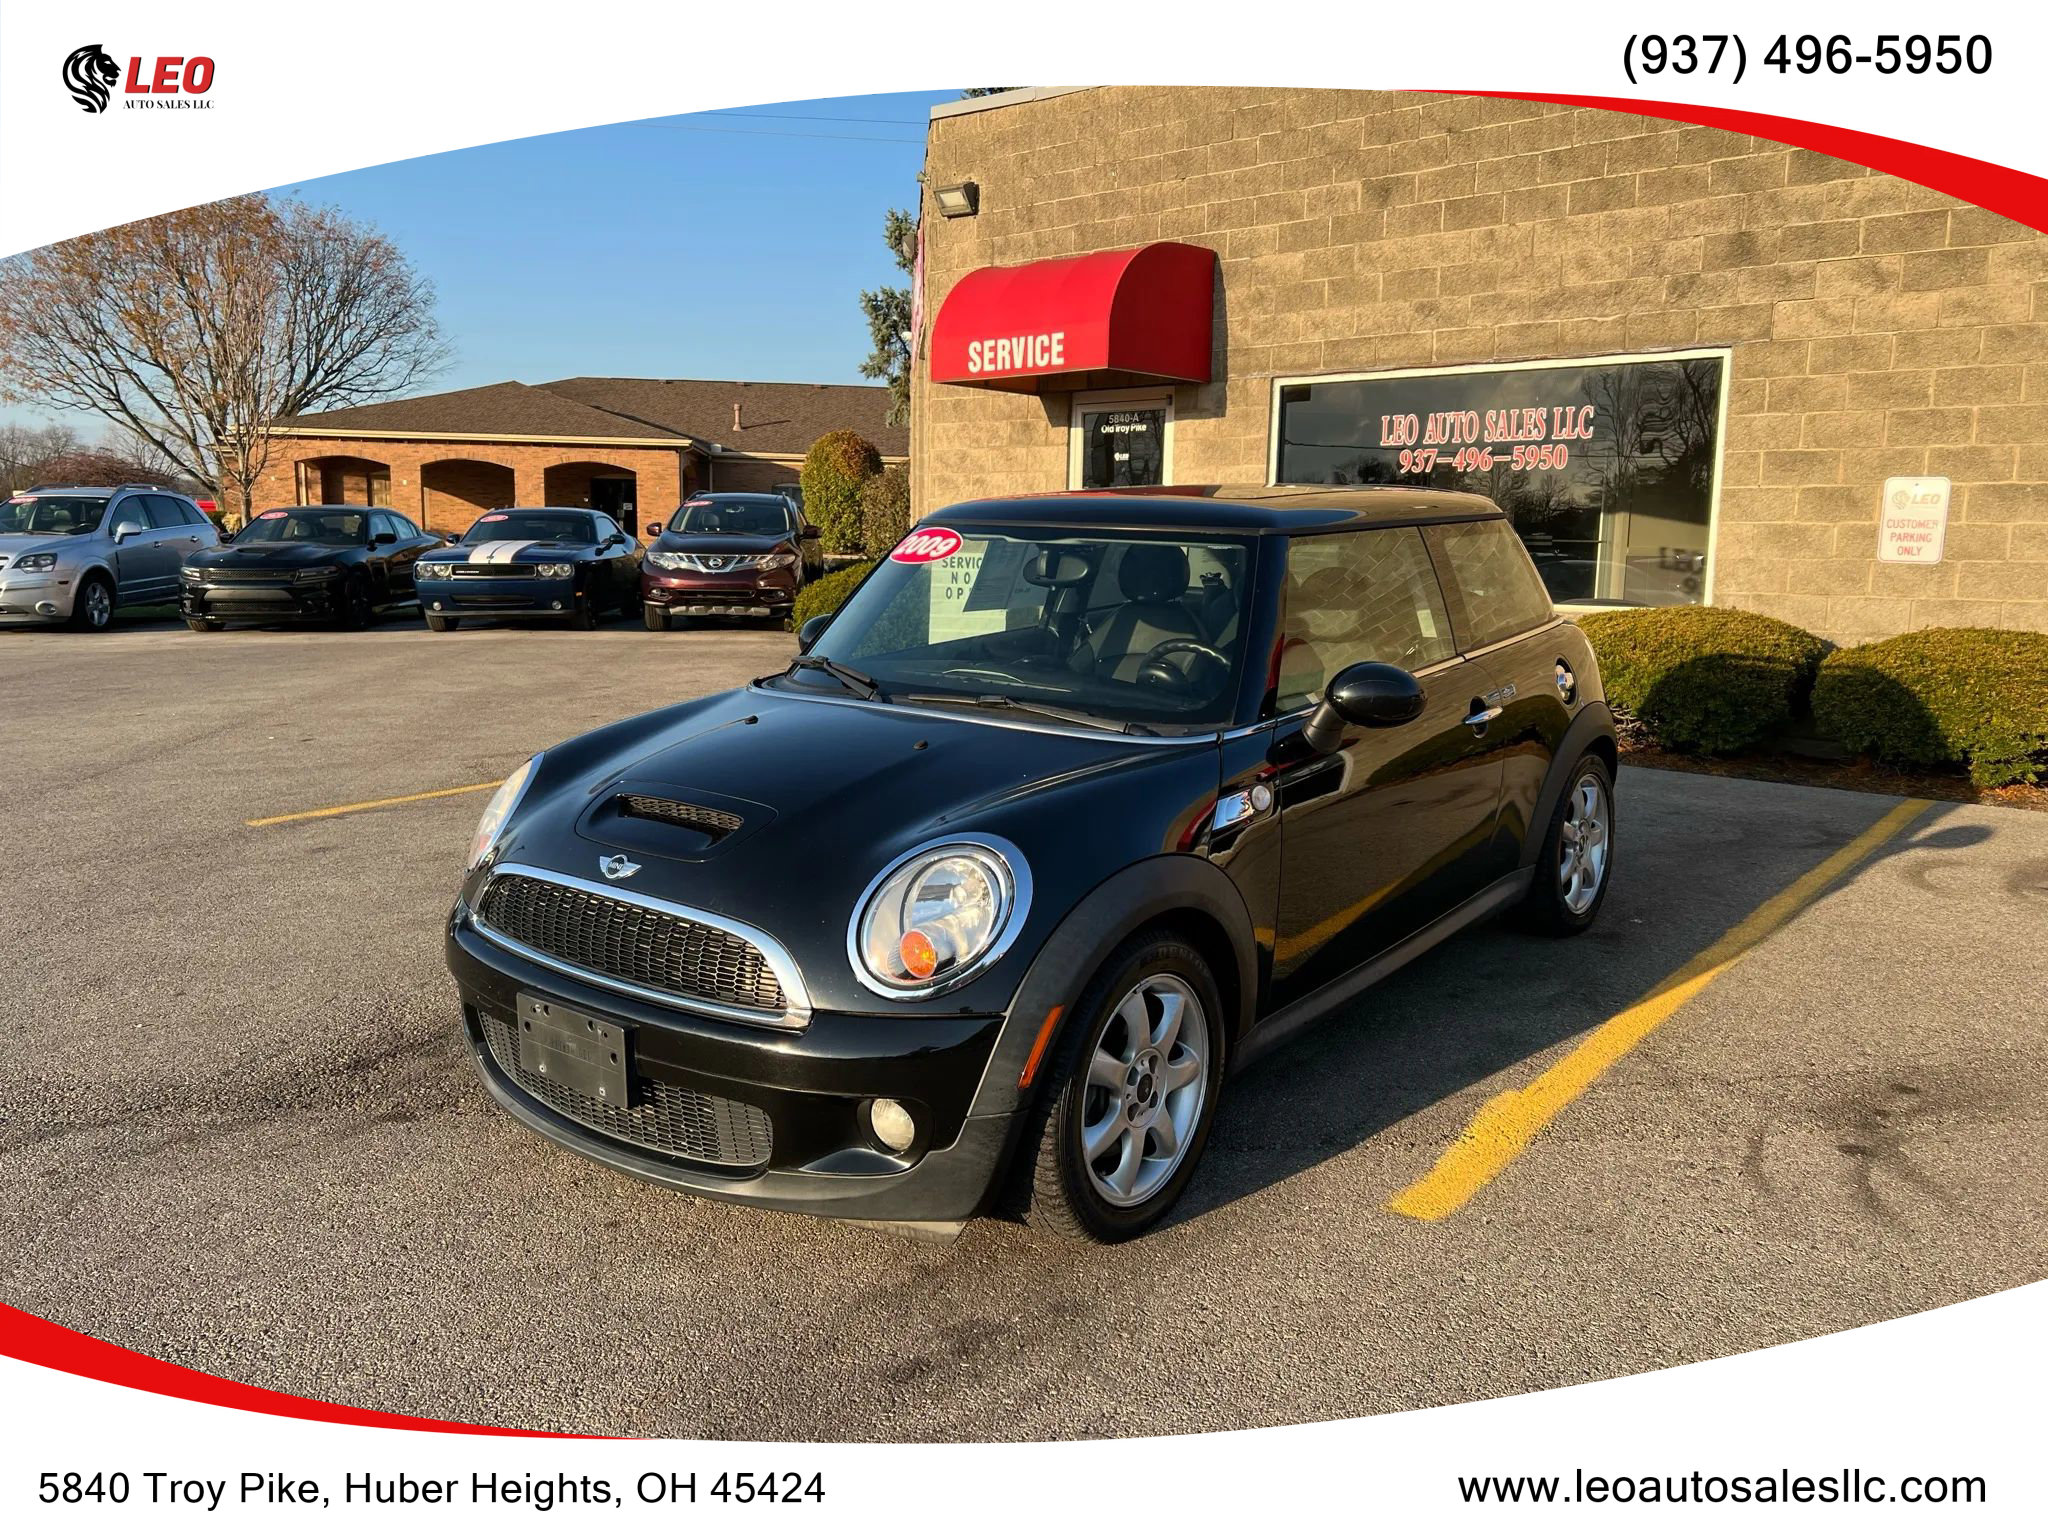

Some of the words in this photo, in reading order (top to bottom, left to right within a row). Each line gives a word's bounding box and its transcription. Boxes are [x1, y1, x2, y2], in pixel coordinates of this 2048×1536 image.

[967, 331, 1065, 374] SERVICE
[1108, 412, 1139, 424] 5840-A
[1101, 424, 1115, 433] Old
[1115, 424, 1130, 435] Troy
[1130, 423, 1147, 432] Pike
[1380, 413, 1419, 446] LEO
[1423, 410, 1480, 445] AUTO
[1484, 406, 1547, 443] SALES
[1552, 404, 1594, 440] LLC
[1399, 443, 1568, 474] 937-496-5950
[1911, 494, 1941, 505] LEO
[1886, 519, 1939, 529] CUSTOMER
[1890, 532, 1933, 543] PARKING
[897, 535, 957, 558] 2009
[1897, 545, 1923, 557] ONLY
[942, 556, 982, 569] SERVIC
[945, 587, 970, 600] OP
